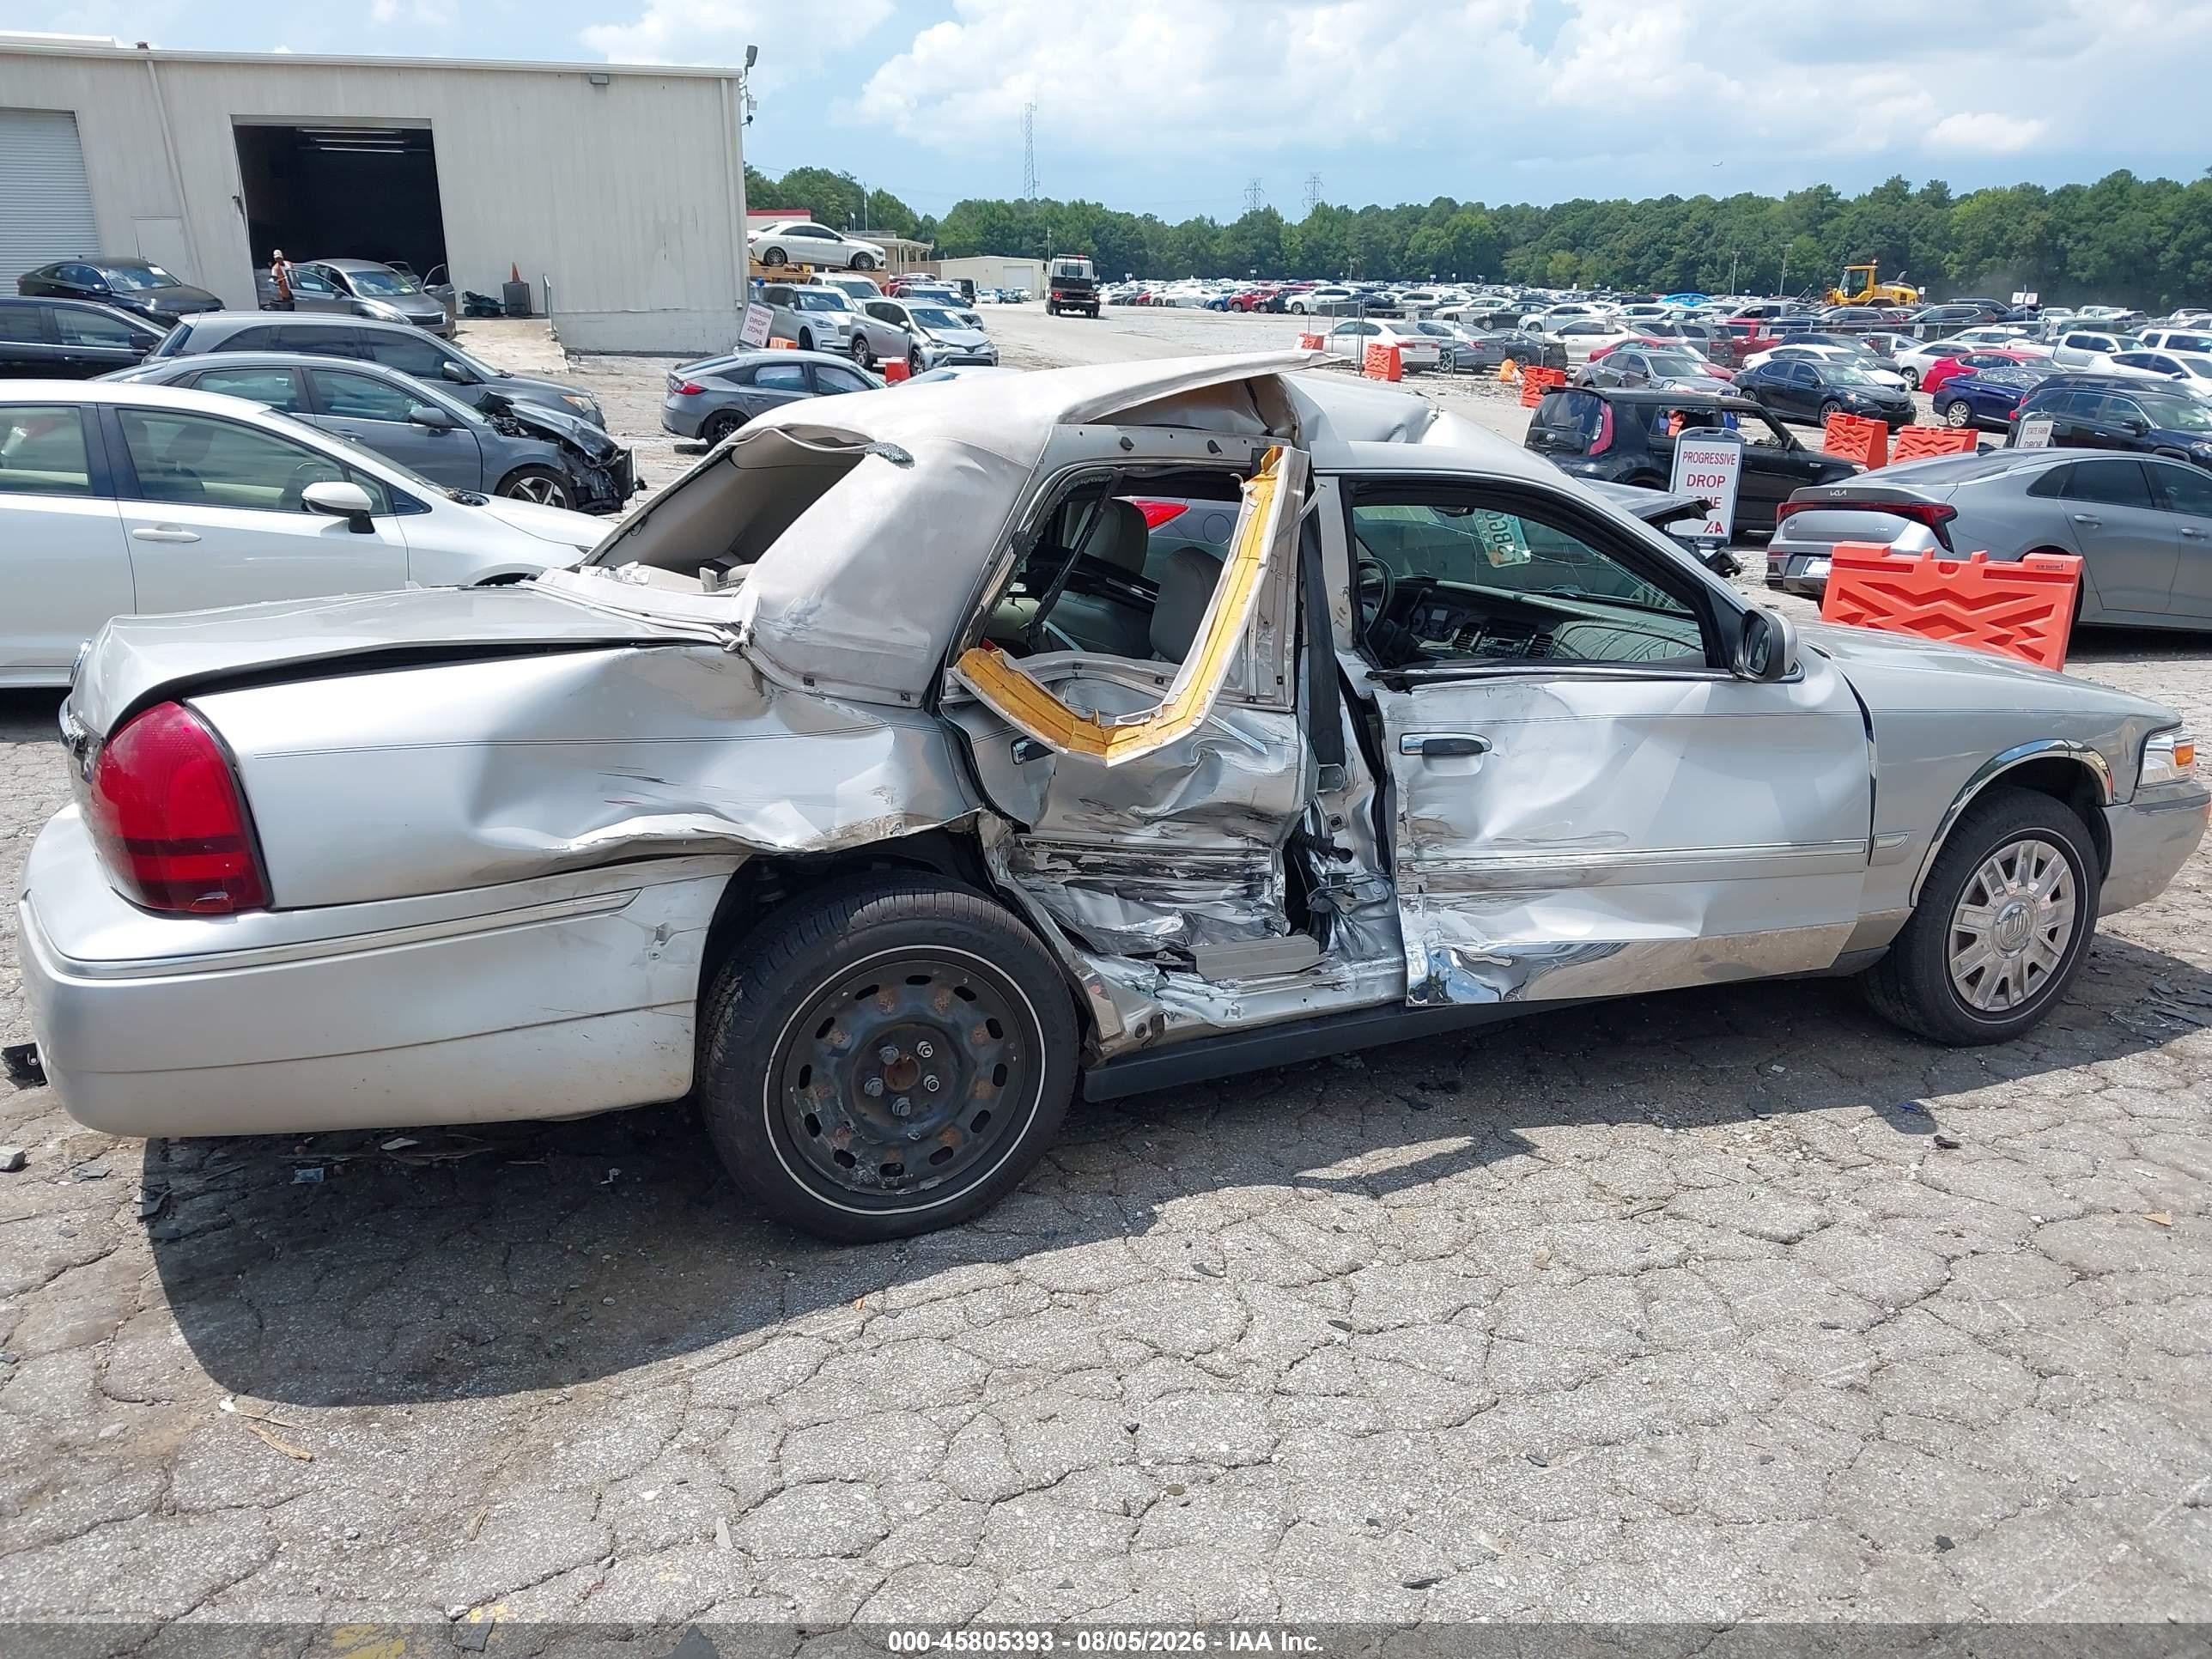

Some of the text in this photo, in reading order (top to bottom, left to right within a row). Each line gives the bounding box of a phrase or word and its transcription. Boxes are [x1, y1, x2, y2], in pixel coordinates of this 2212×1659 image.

[750, 317, 766, 325] DROP
[748, 325, 763, 336] ZONE
[1682, 451, 1736, 465] PROGRESSIVE
[1686, 474, 1726, 489] DROP
